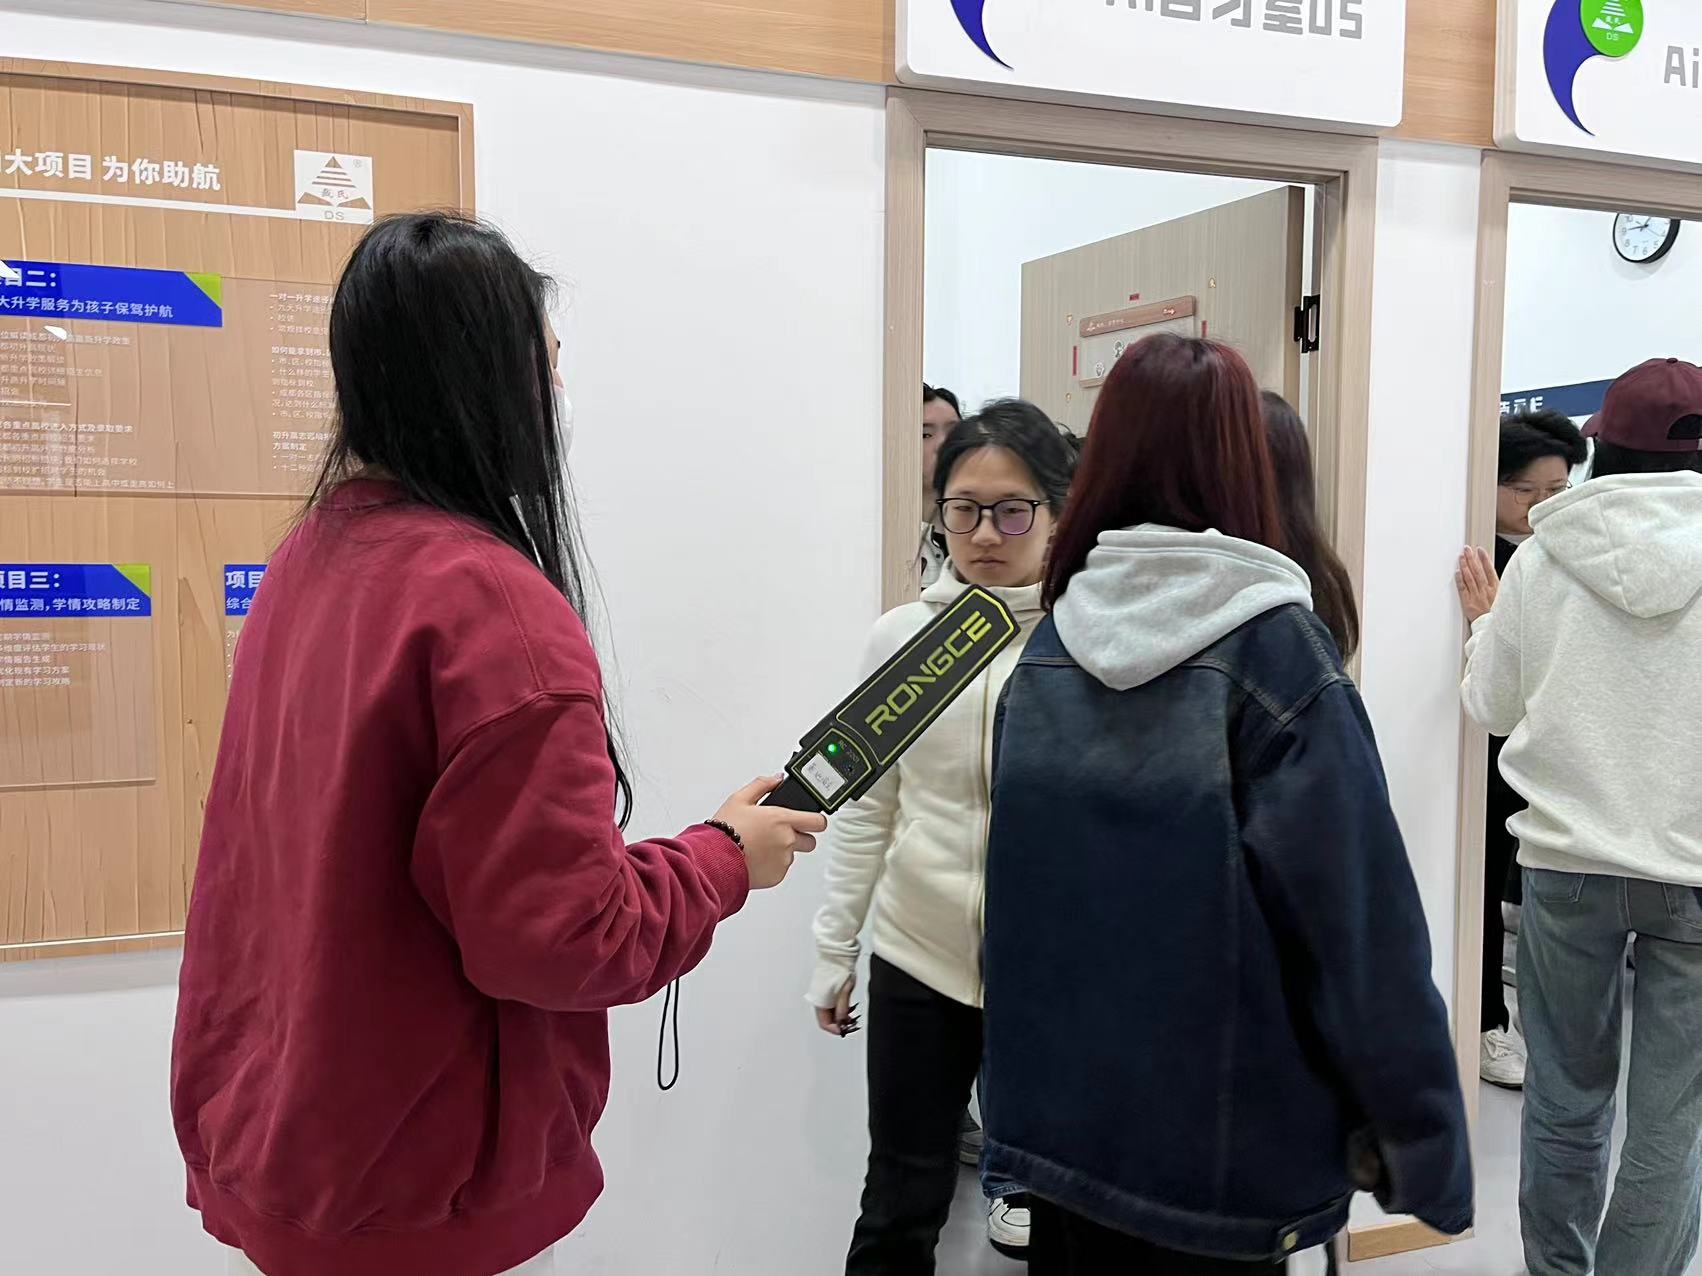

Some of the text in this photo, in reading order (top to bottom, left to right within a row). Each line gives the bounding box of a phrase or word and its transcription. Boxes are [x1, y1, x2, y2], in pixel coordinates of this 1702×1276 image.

[1664, 45, 1699, 88] Ai
[0, 148, 221, 190] 大项目 为你助航
[324, 210, 345, 220] DS
[0, 268, 57, 287] 目二：
[0, 295, 174, 319] 大升学服务为孩子保驾护航
[864, 610, 993, 736] RONGCE
